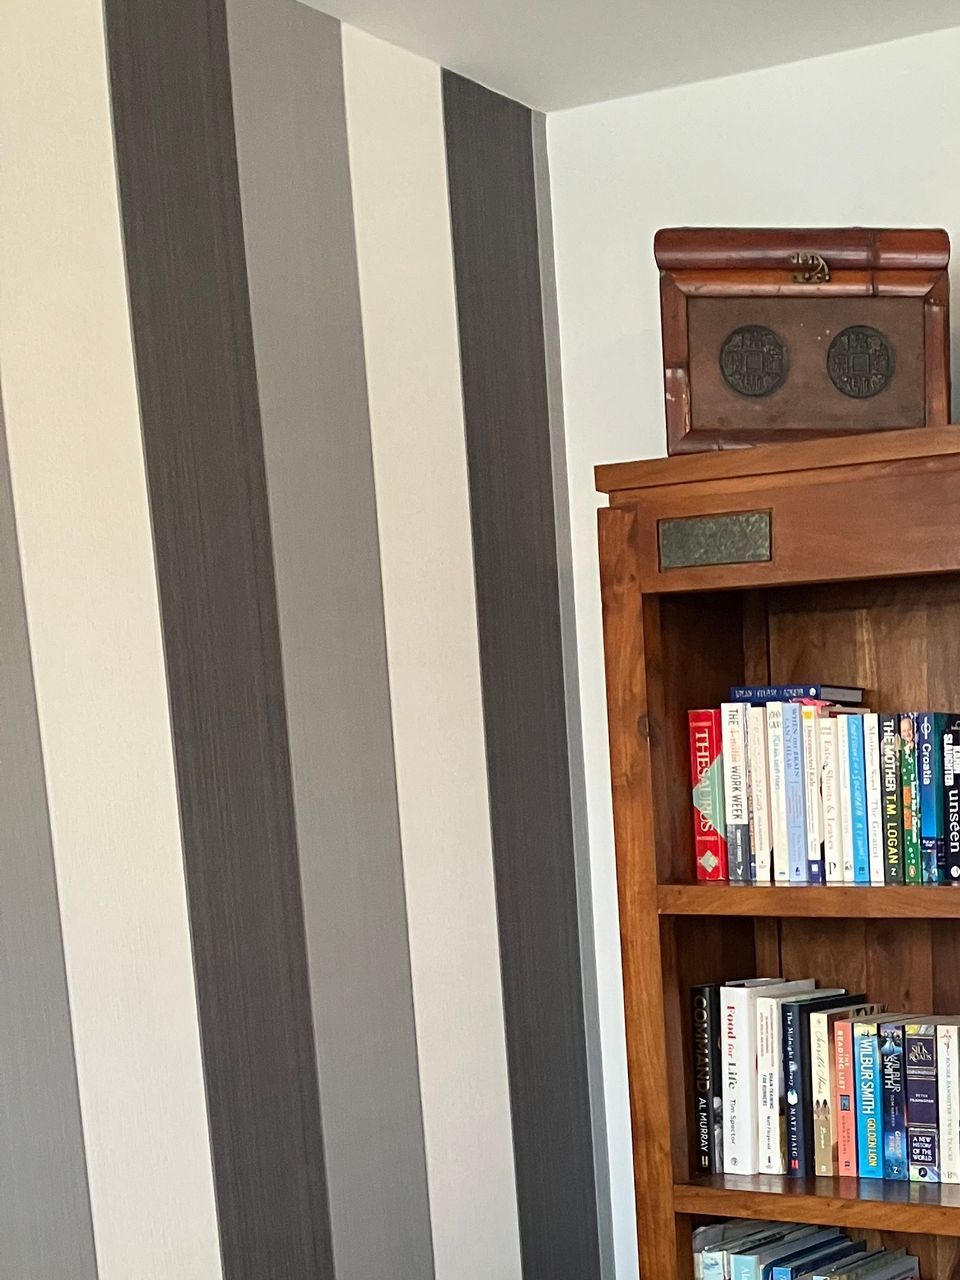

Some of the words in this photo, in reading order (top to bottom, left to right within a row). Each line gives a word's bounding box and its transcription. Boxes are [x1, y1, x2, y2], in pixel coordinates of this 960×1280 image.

[728, 710, 738, 726] THE
[883, 720, 894, 743] THE
[883, 744, 897, 791] MOTHER
[921, 743, 932, 785] Croatia
[944, 734, 953, 786] SLAUGHTER
[695, 728, 714, 832] THESAURUS
[730, 766, 741, 792] WORK
[825, 770, 834, 801] Shoots
[732, 794, 742, 819] WEEK
[827, 805, 835, 813] &
[886, 794, 896, 818] T.M.
[949, 790, 960, 853] unseen
[828, 818, 837, 850] Leaves
[887, 823, 898, 863] LOGAN
[726, 1004, 736, 1040] Food
[693, 995, 710, 1092] COMMAND
[727, 1043, 735, 1058] for
[786, 1027, 795, 1060] Midnight
[860, 1039, 873, 1080] WILBUR
[727, 1062, 737, 1089] Life
[884, 1055, 893, 1089] SMITH
[892, 1054, 901, 1092] WILBUR
[698, 1097, 707, 1109] AL
[861, 1081, 875, 1114] SMITH
[698, 1113, 708, 1152] MURRAY
[729, 1115, 737, 1144] Spector
[867, 1118, 877, 1148] GOLDEN
[868, 1149, 877, 1166] LION
